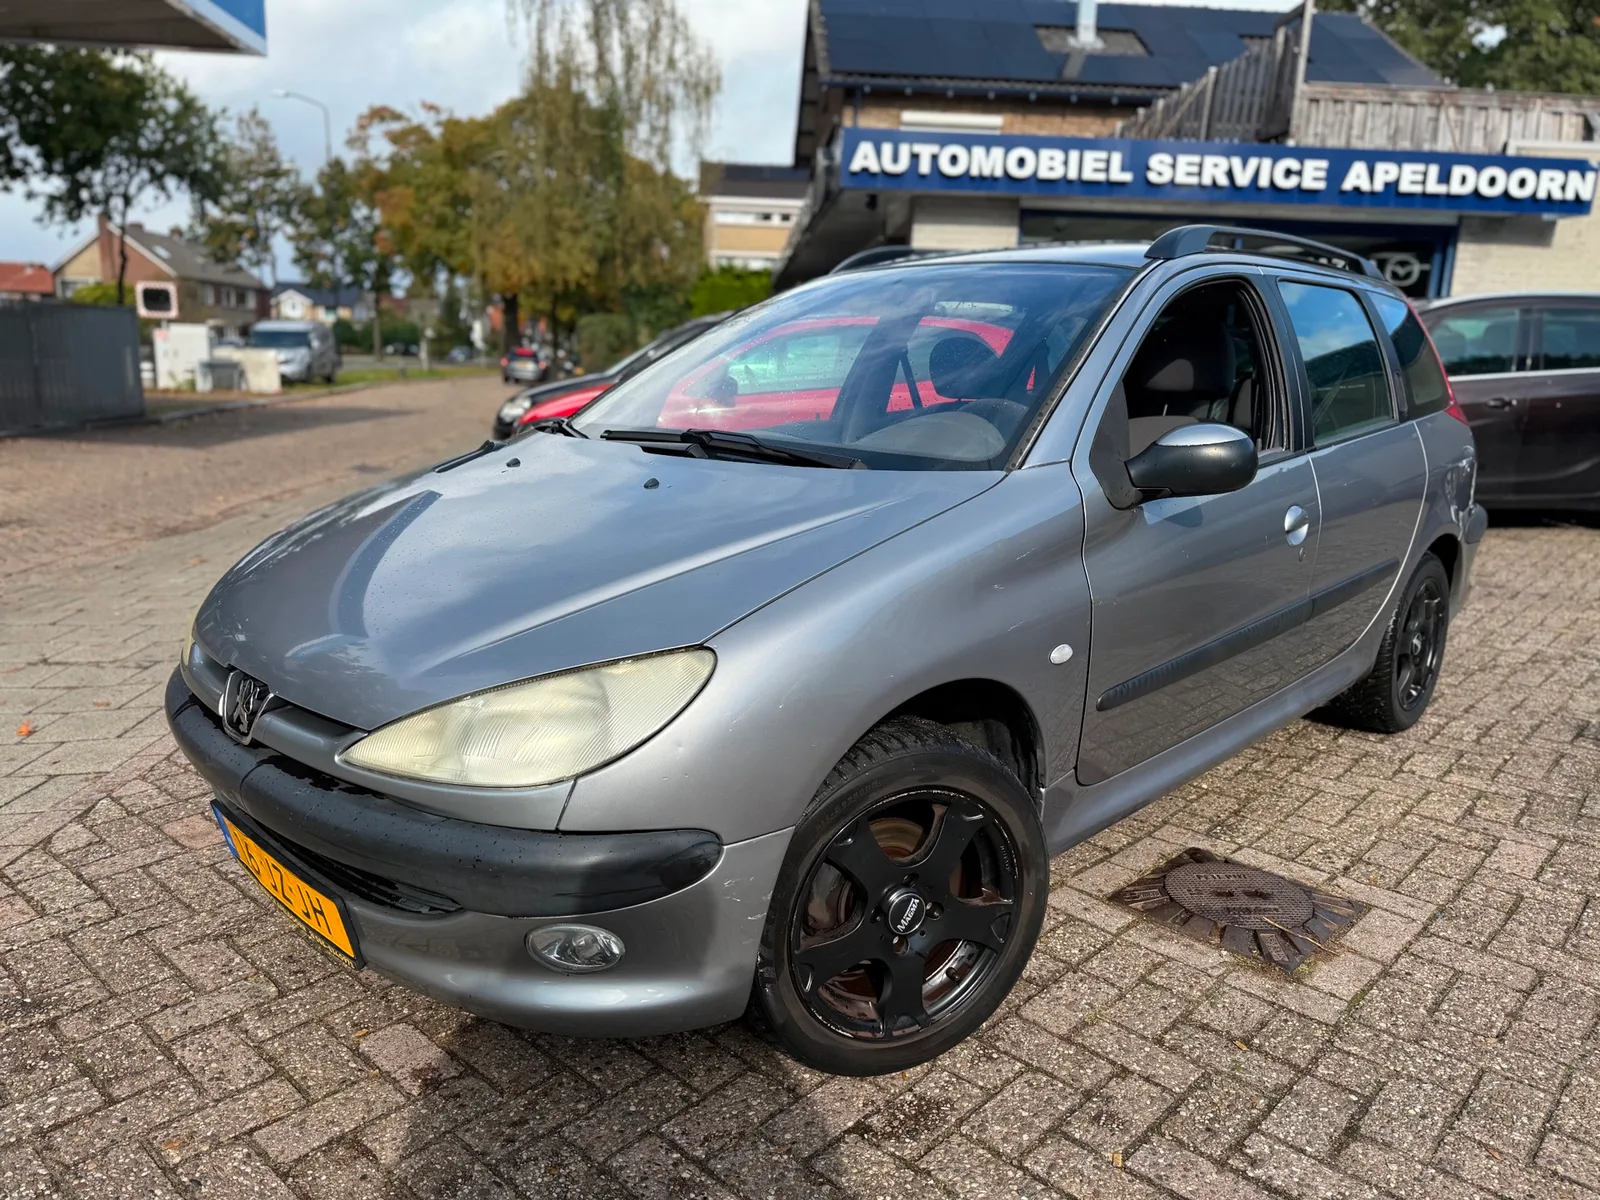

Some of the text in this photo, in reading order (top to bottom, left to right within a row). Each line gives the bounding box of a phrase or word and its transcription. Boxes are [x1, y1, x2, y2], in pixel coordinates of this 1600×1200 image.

[849, 140, 1596, 202] AUTOMOBIEL SERVICE APELDOORN
[896, 897, 920, 932] MAGMA
